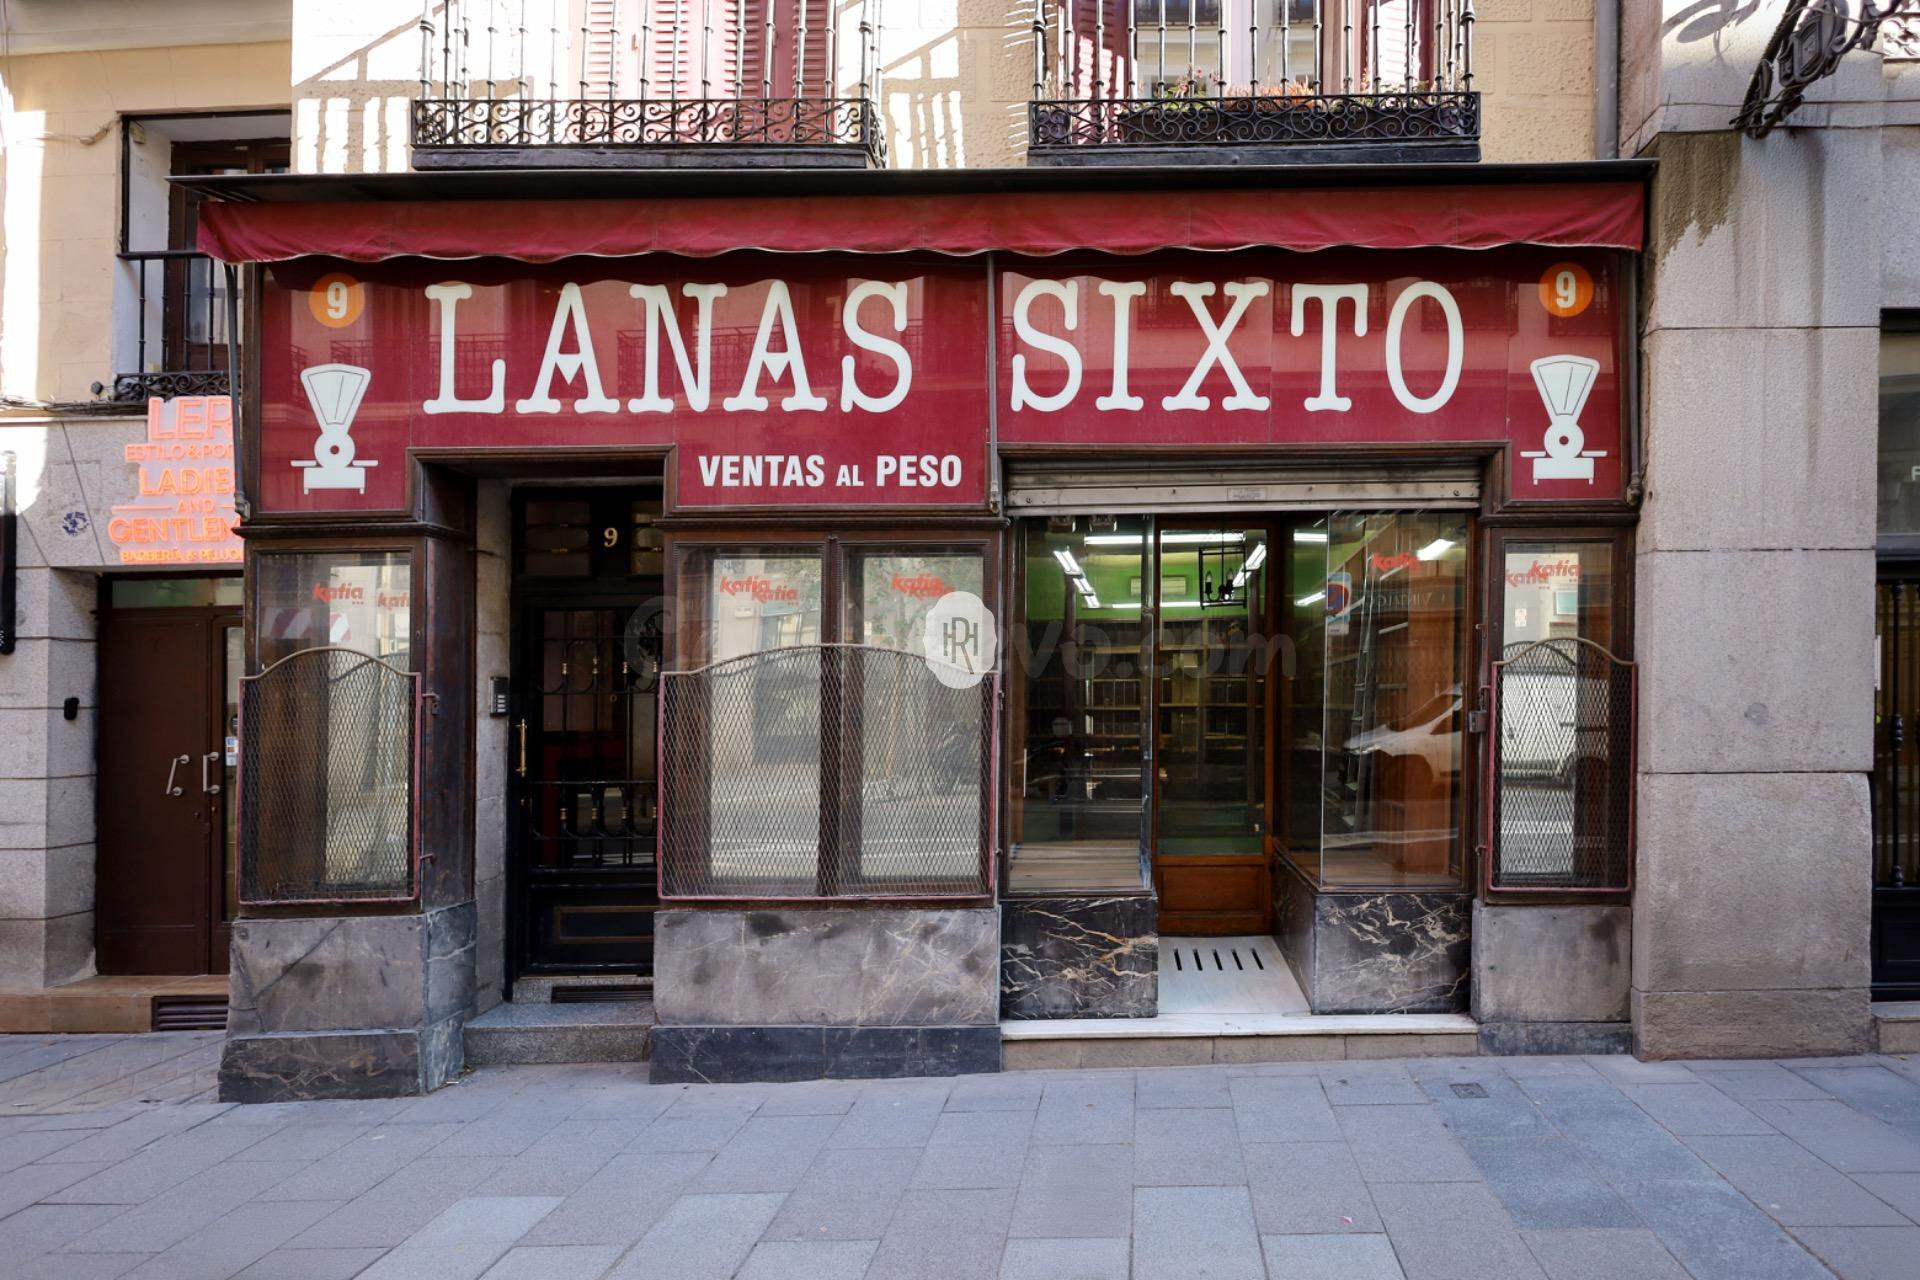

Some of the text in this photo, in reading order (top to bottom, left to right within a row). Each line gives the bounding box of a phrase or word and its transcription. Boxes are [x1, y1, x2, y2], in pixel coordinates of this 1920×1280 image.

[1555, 271, 1575, 307] 9
[327, 281, 347, 320] 9
[423, 279, 1465, 415] LANAS SIXTO
[698, 454, 963, 487] VENTAS AL PESO
[140, 468, 235, 496] LADIE
[176, 499, 215, 513] AND
[603, 527, 619, 548] 9
[201, 548, 243, 561] PELUQ
[1530, 559, 1584, 580] katia
[313, 582, 364, 604] katia
[719, 576, 770, 597] katia
[752, 586, 799, 604] katia
